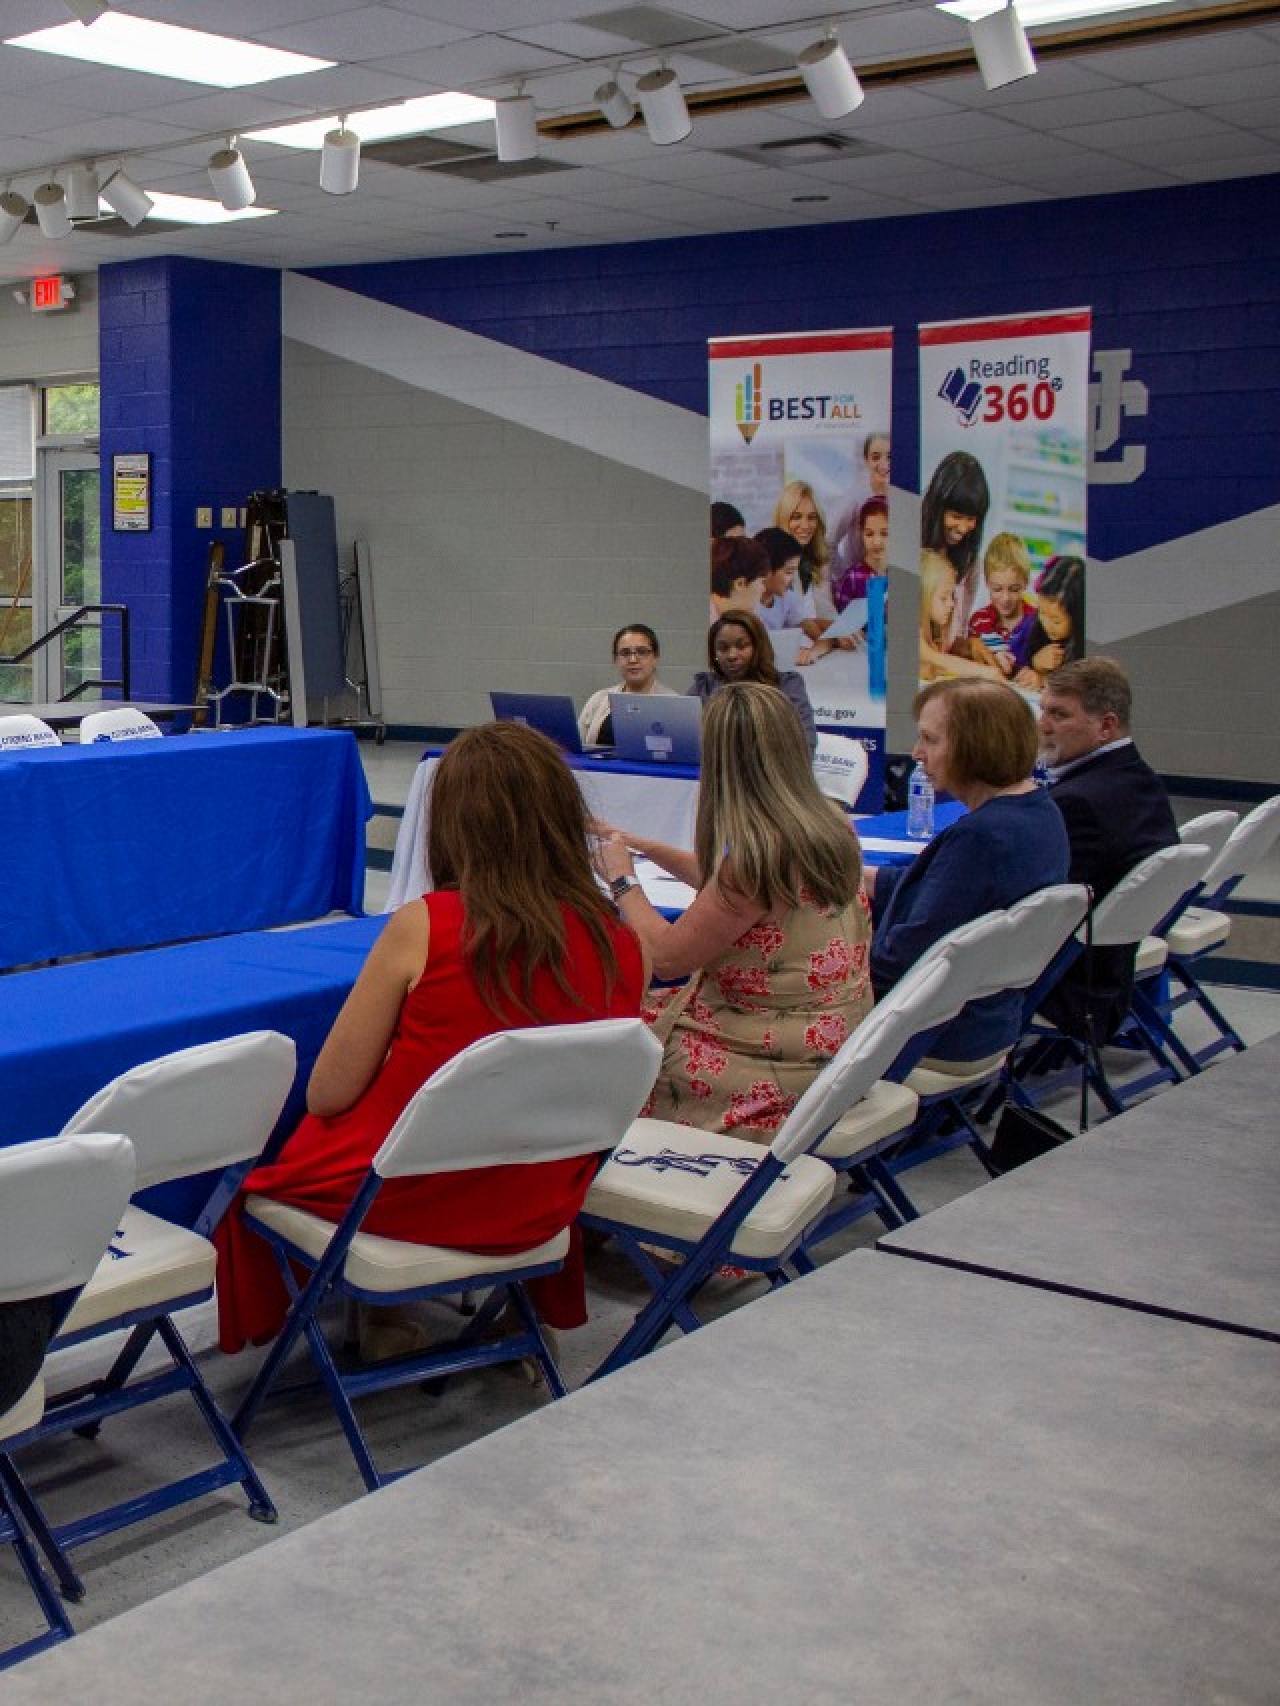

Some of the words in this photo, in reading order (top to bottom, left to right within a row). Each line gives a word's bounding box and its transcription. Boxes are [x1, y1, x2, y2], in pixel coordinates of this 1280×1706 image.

[35, 280, 60, 307] EXIT
[969, 354, 1051, 381] Reading
[768, 395, 831, 421] BEST
[831, 403, 862, 419] ALL
[813, 706, 857, 721] du.gov
